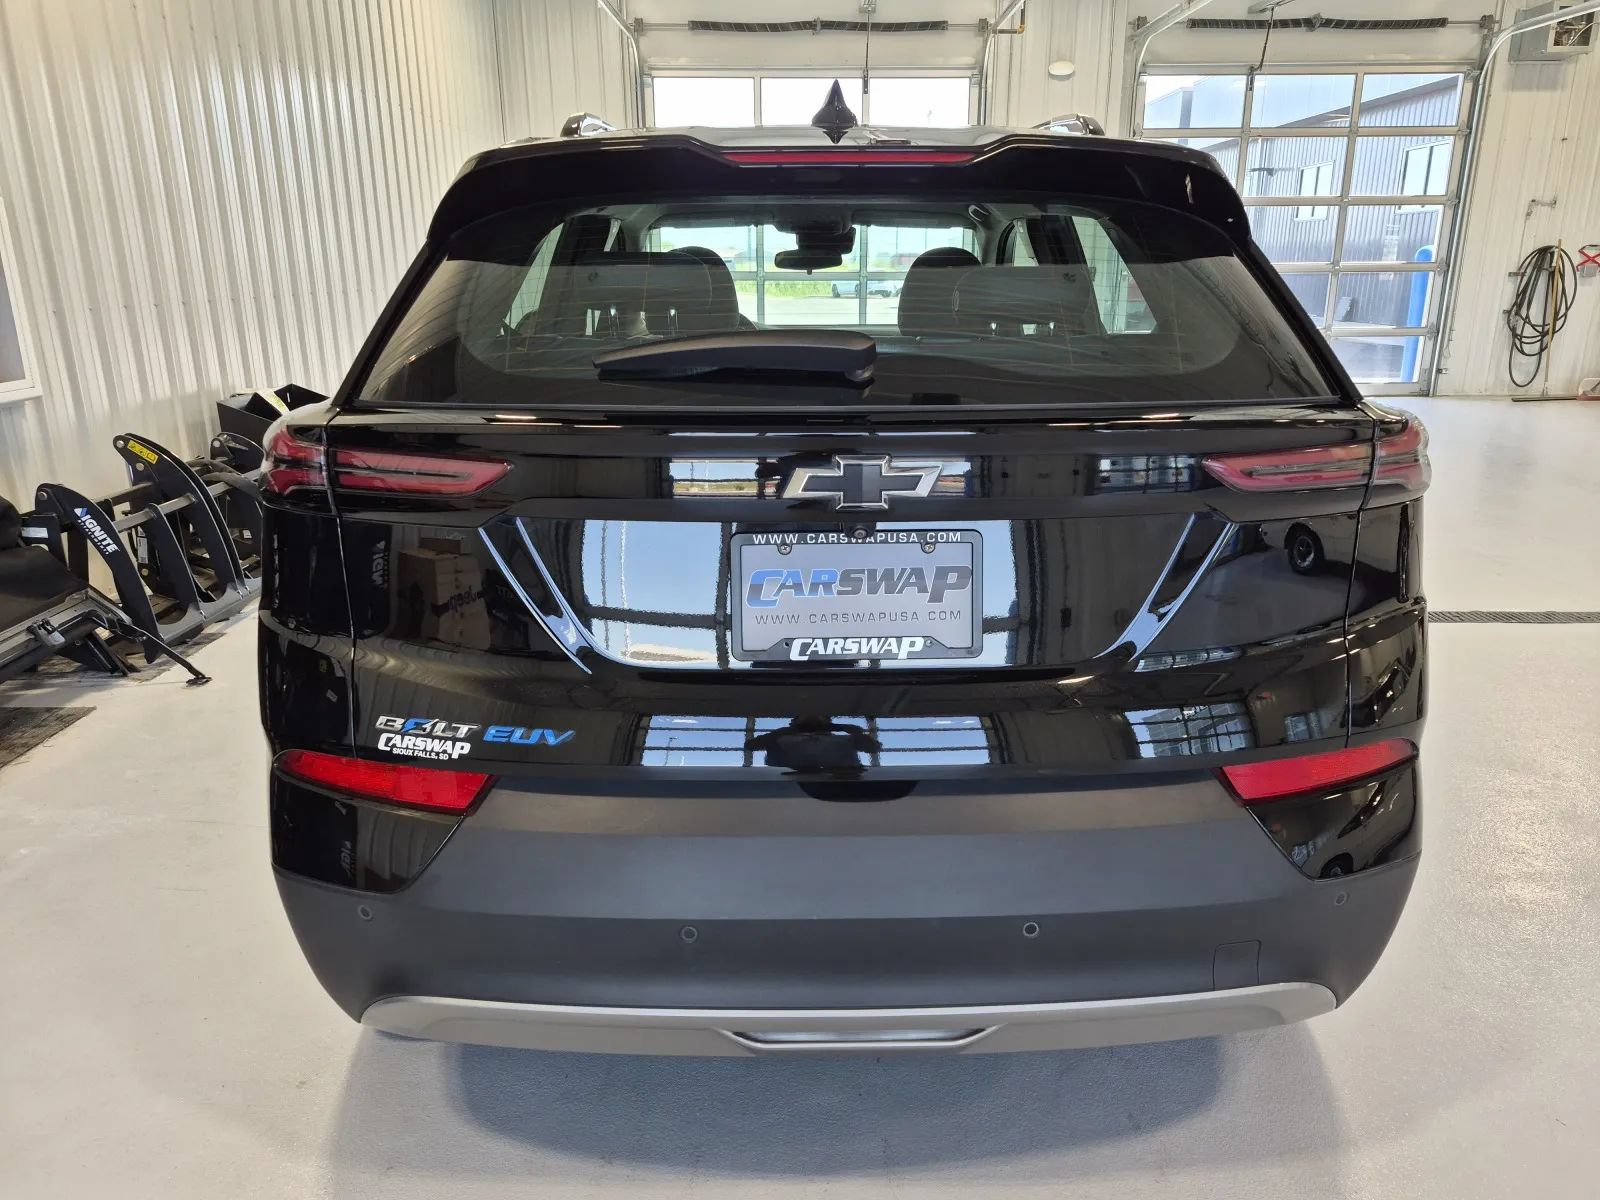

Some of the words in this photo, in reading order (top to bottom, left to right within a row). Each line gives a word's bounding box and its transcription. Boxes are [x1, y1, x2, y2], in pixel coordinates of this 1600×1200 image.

[80, 514, 119, 553] IGNITE
[746, 565, 973, 609] CARSWAP
[789, 636, 925, 661] CARSWAP
[375, 715, 481, 739] BOLT
[483, 725, 576, 746] EUV
[377, 732, 472, 760] CARSWAP
[392, 747, 414, 757] SIOUX
[413, 750, 438, 760] FALLS,
[438, 752, 449, 761] SD
